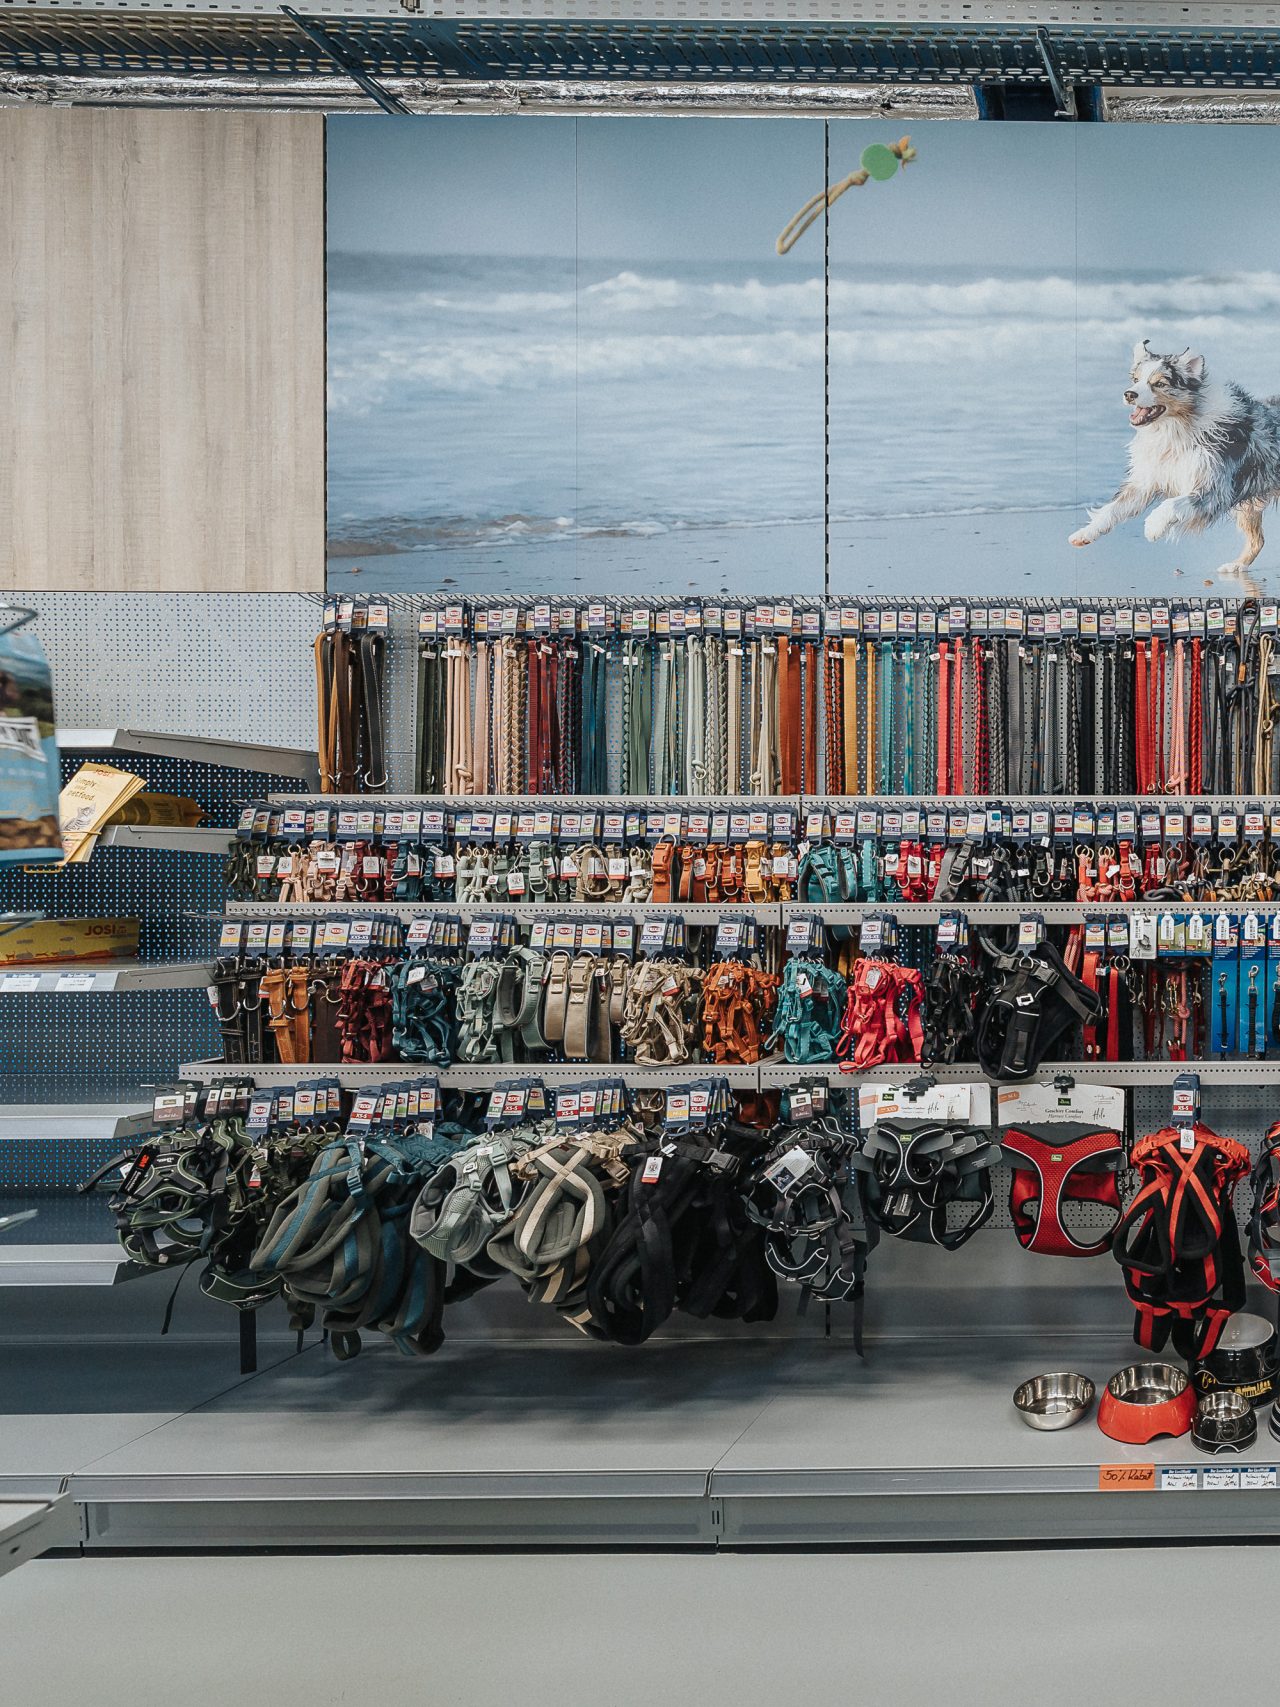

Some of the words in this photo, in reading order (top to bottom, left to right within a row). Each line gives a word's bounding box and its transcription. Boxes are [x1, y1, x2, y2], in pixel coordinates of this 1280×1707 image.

[85, 924, 116, 936] JOSI
[507, 1095, 523, 1103] TRIXIE
[692, 1095, 706, 1103] TRIXIE
[358, 1102, 372, 1110] TRIXIE
[559, 1100, 577, 1108] TRIXIE
[669, 1100, 687, 1108] TRIXIE
[252, 1106, 268, 1114] TRIXIE
[1102, 1469, 1126, 1482] 50%
